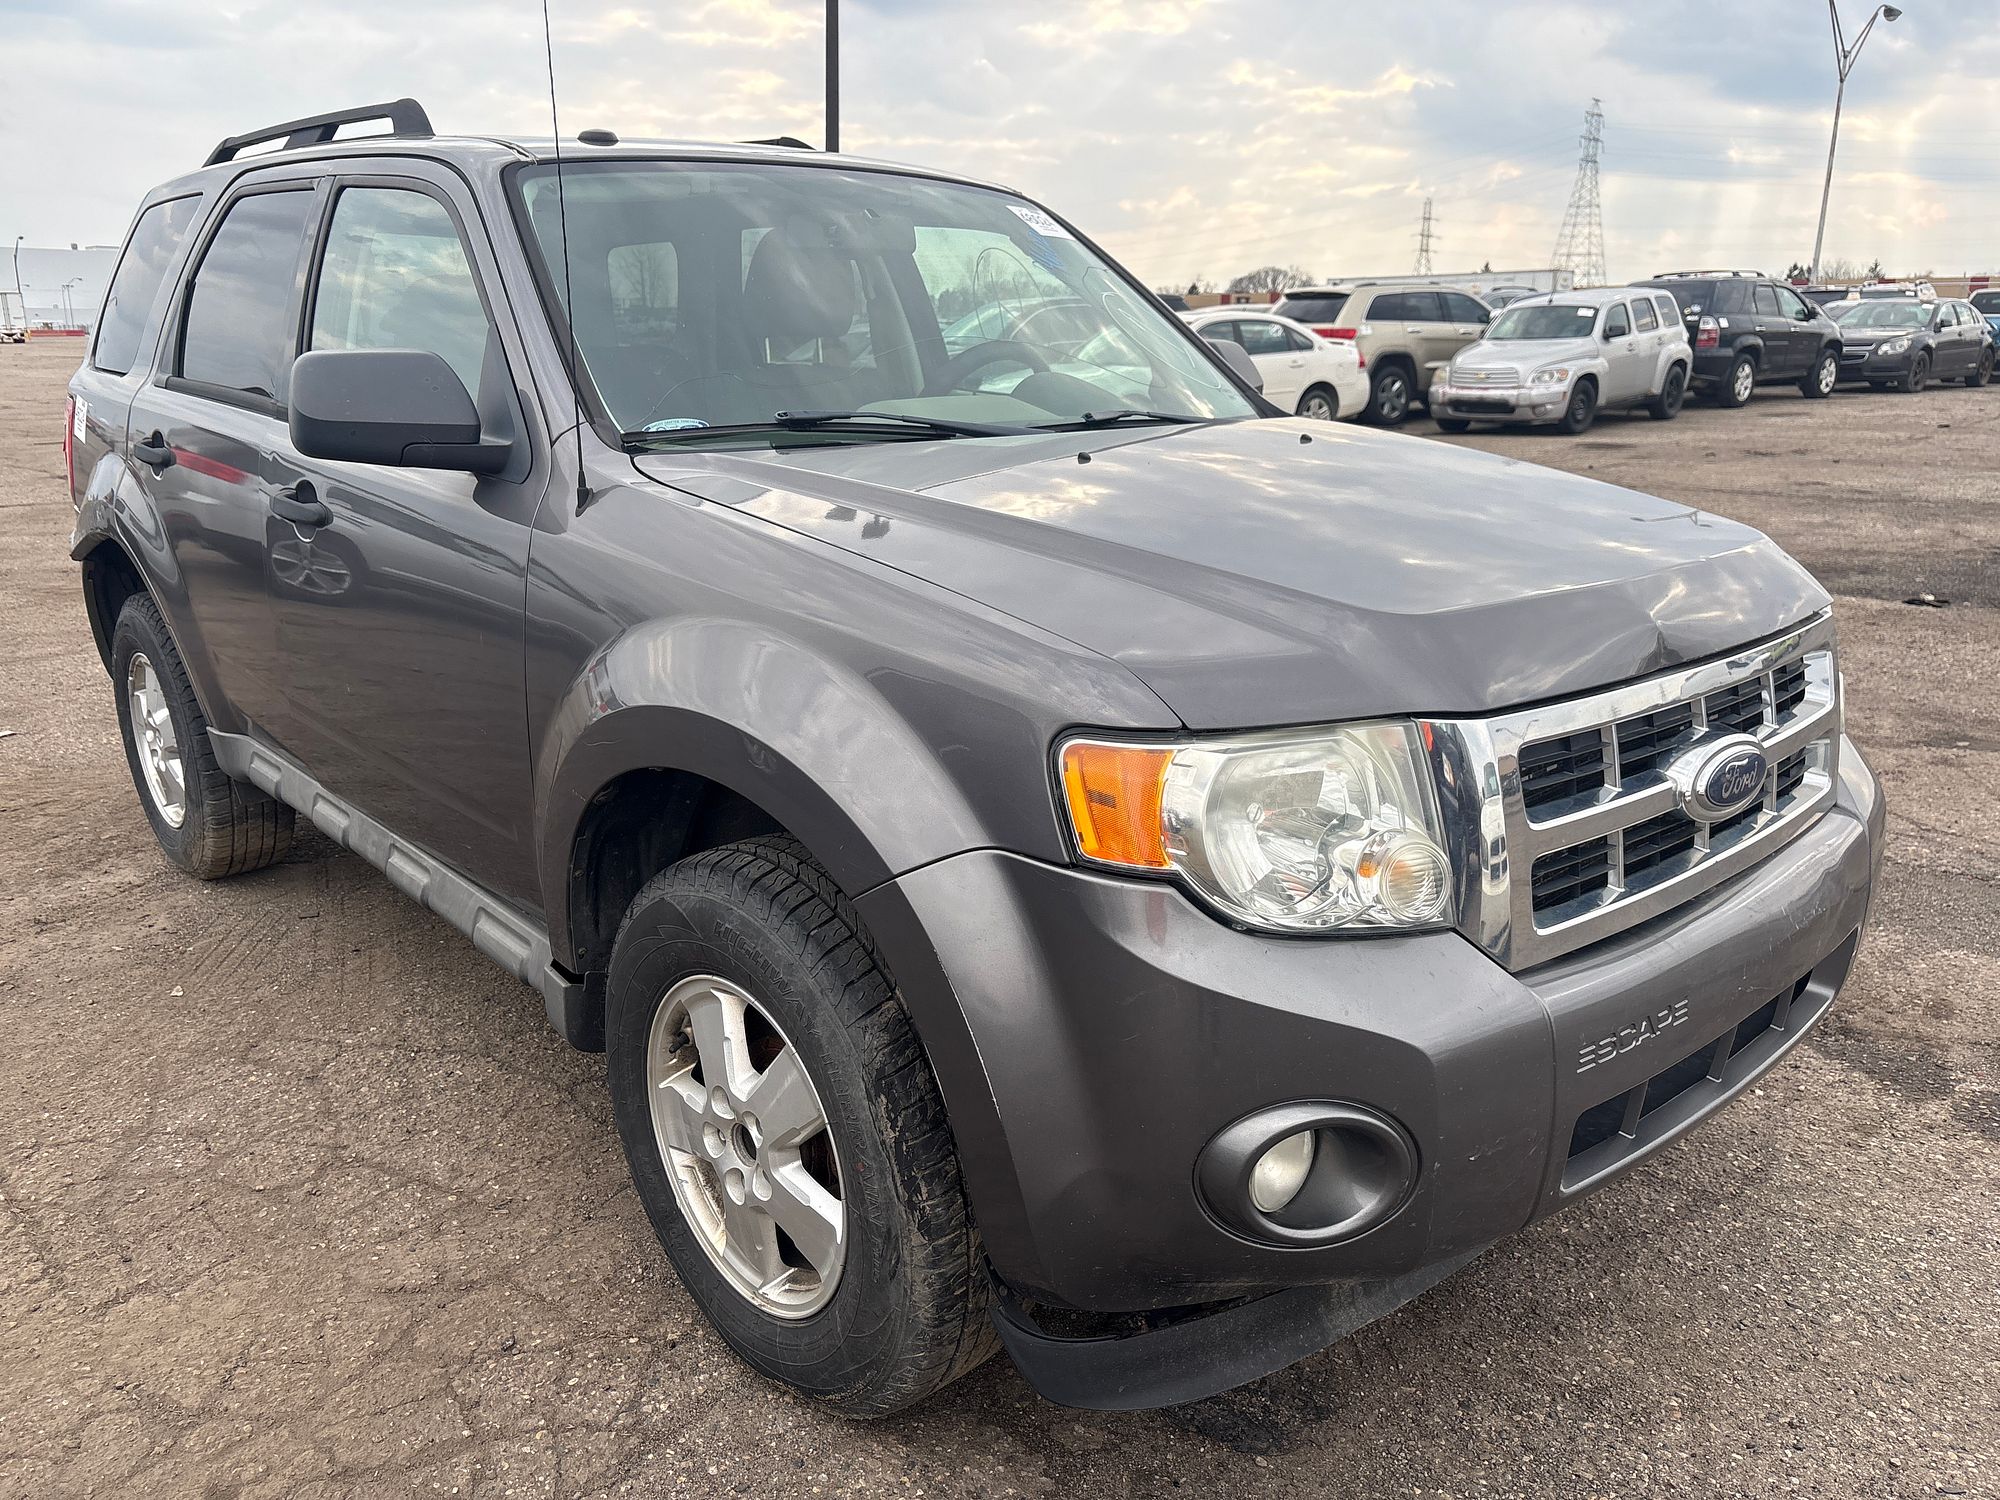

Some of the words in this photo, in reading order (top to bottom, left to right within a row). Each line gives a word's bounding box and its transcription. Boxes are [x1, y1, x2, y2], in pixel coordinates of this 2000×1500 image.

[1721, 758, 1758, 799] Ford
[713, 918, 820, 1038] HIGHWAY
[1576, 998, 1689, 1074] ESCAPE
